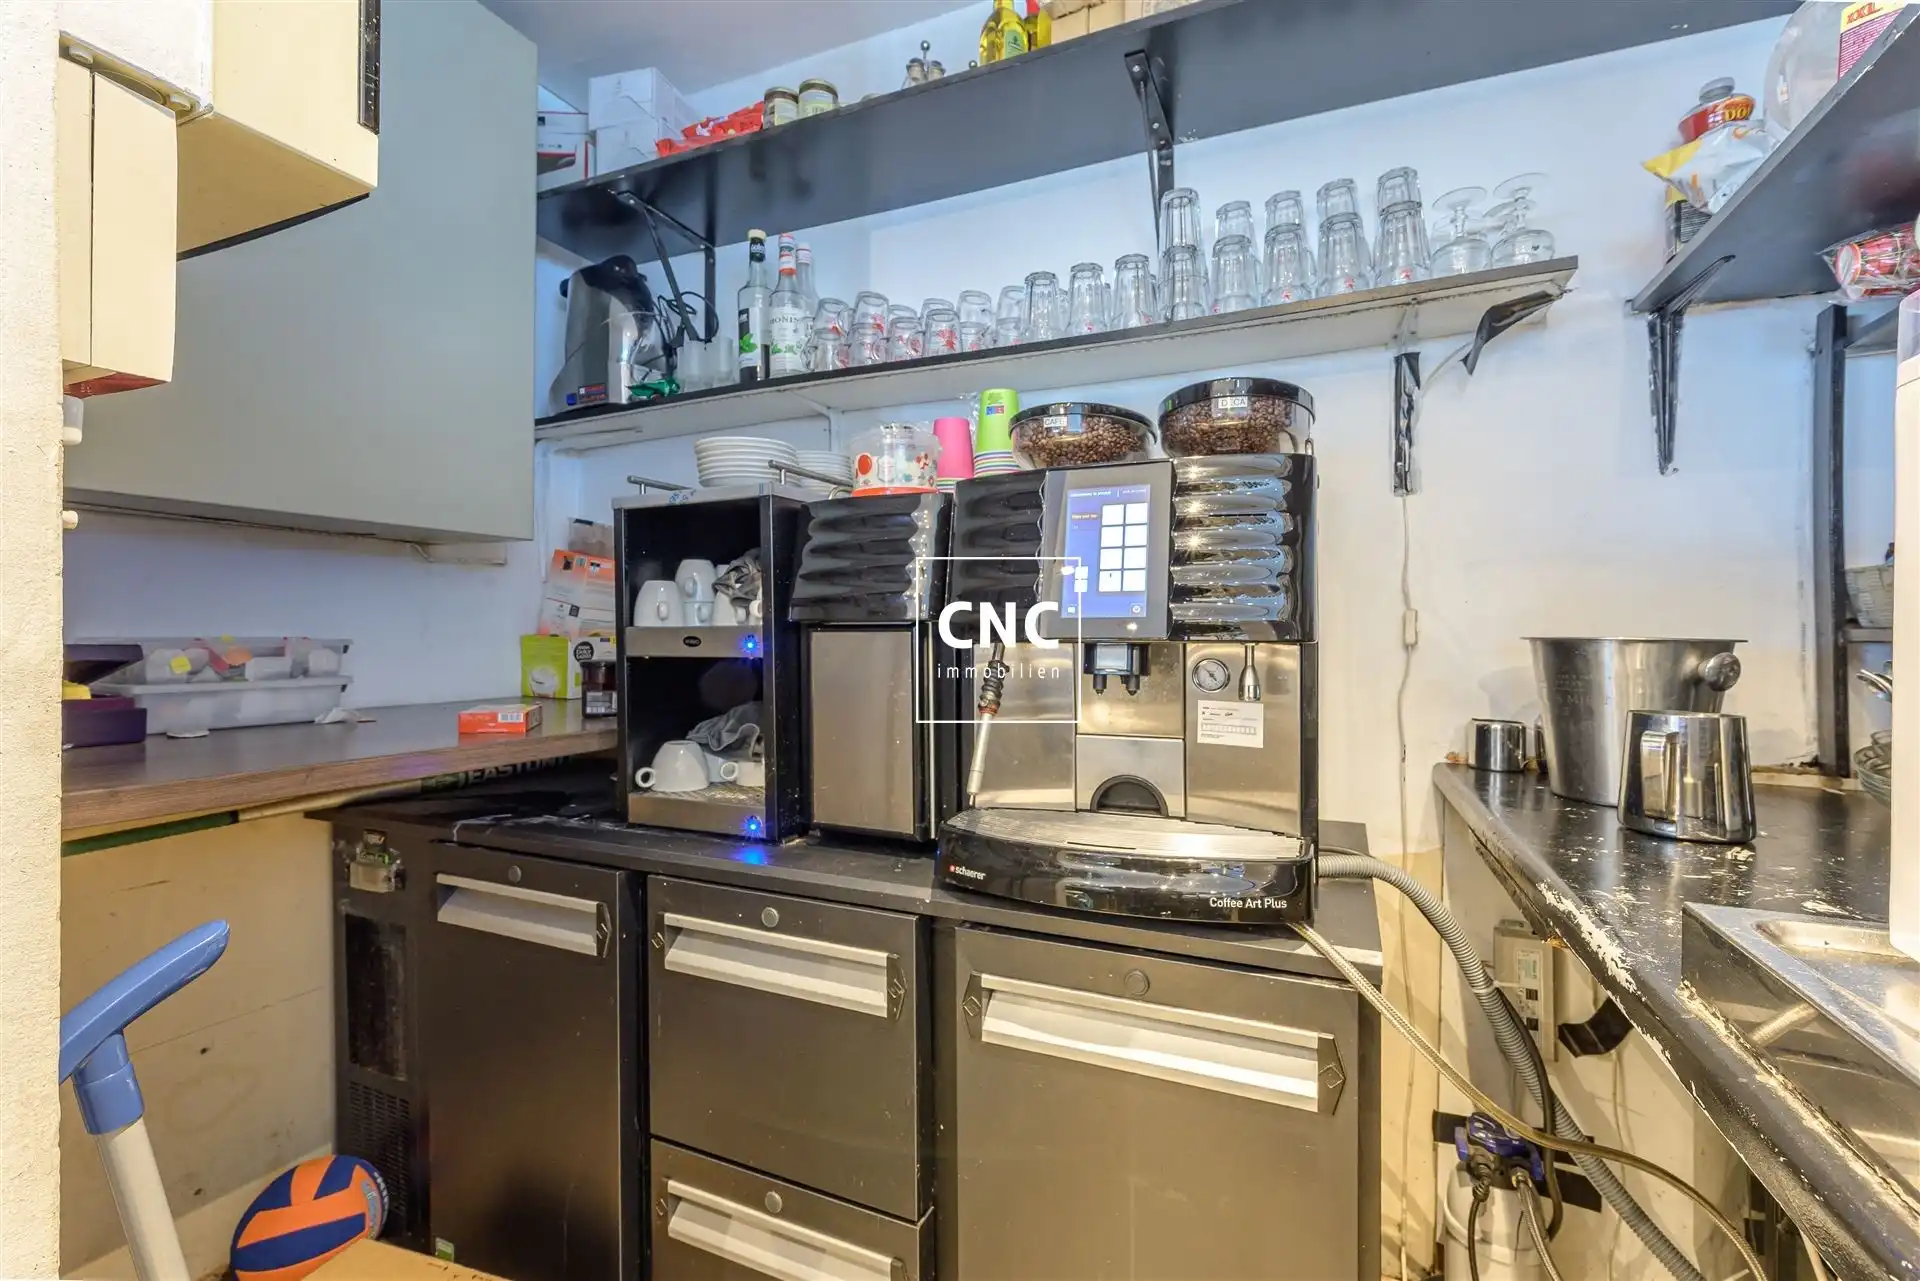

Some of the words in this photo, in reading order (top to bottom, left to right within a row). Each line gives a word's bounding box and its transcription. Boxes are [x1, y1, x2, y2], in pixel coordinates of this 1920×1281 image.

[1221, 399, 1246, 407] DCA
[955, 866, 986, 880] schaerer
[1209, 897, 1243, 908] Coffee
[1245, 898, 1262, 908] Art
[1264, 898, 1288, 909] Plus
